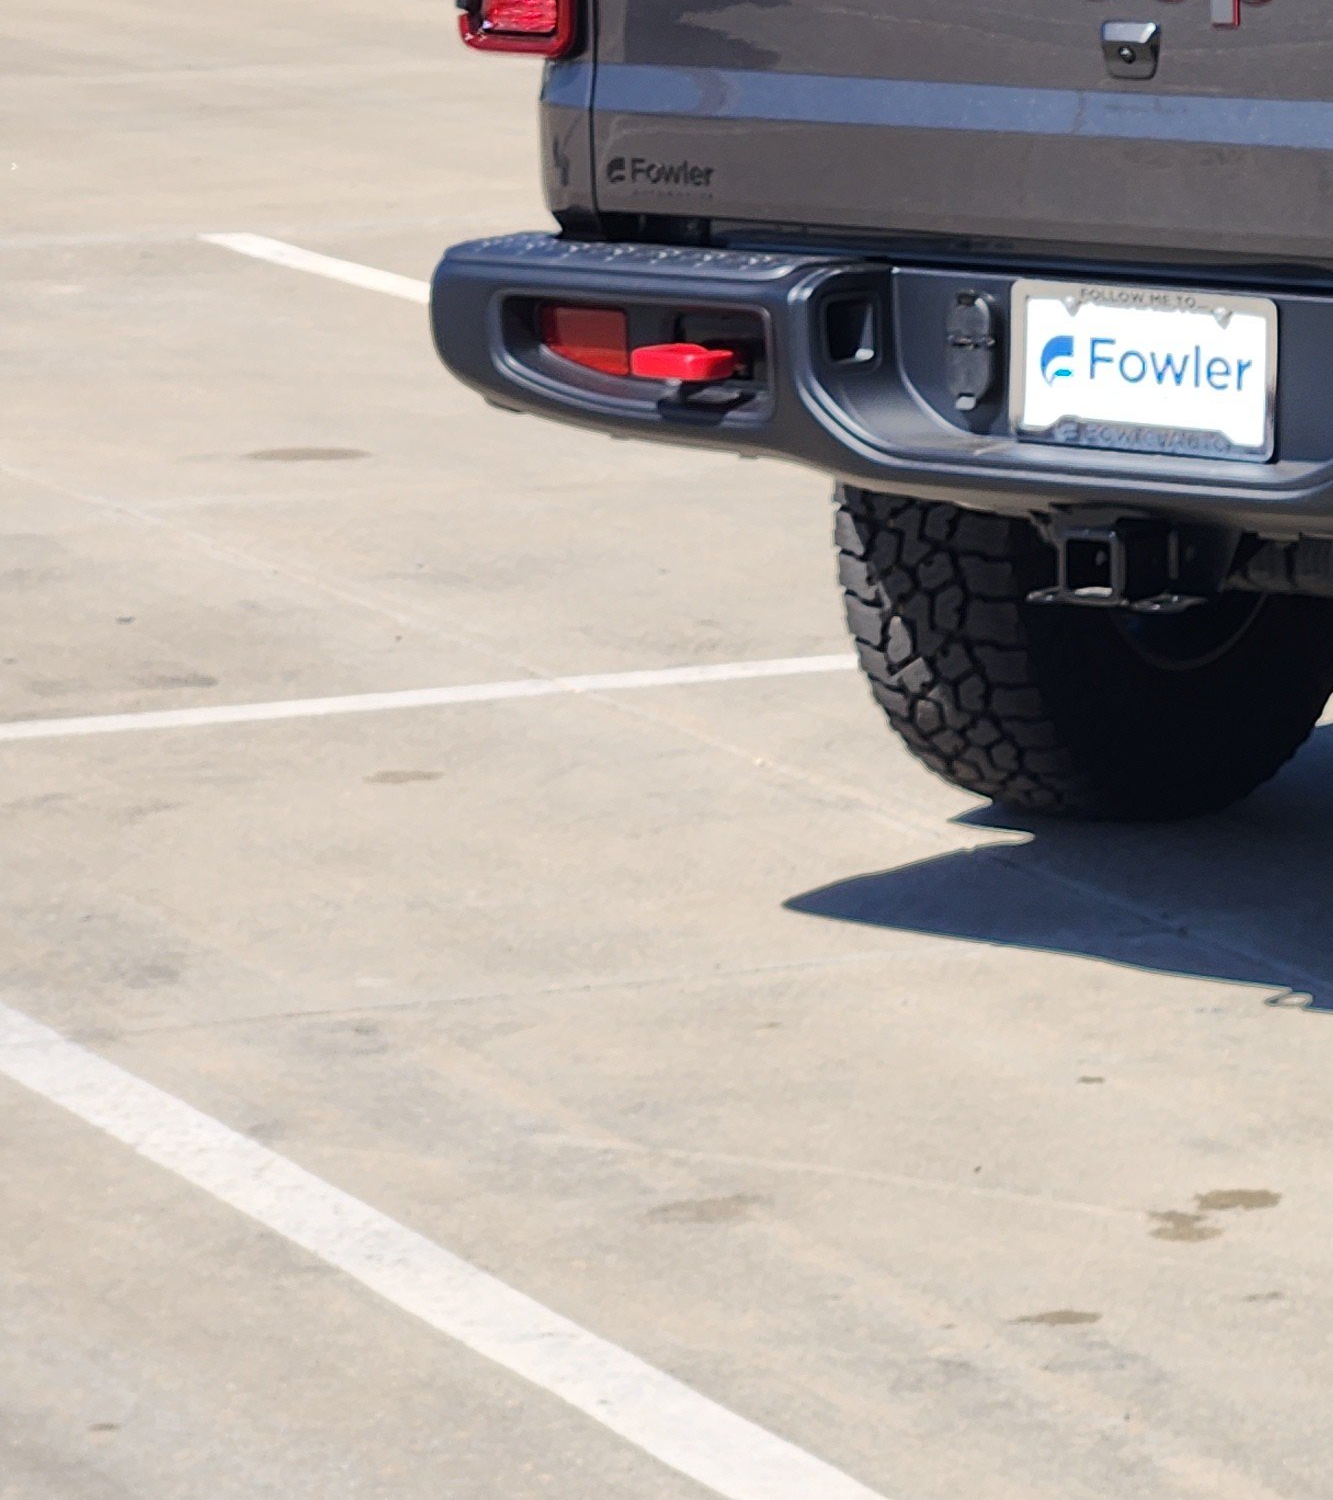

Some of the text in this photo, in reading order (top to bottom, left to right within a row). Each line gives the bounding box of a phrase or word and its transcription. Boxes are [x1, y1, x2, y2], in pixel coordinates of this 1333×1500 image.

[630, 157, 716, 187] Fowler
[1080, 288, 1145, 303] FOLLOW
[1149, 294, 1168, 305] ME
[1089, 337, 1253, 391] Fowler
